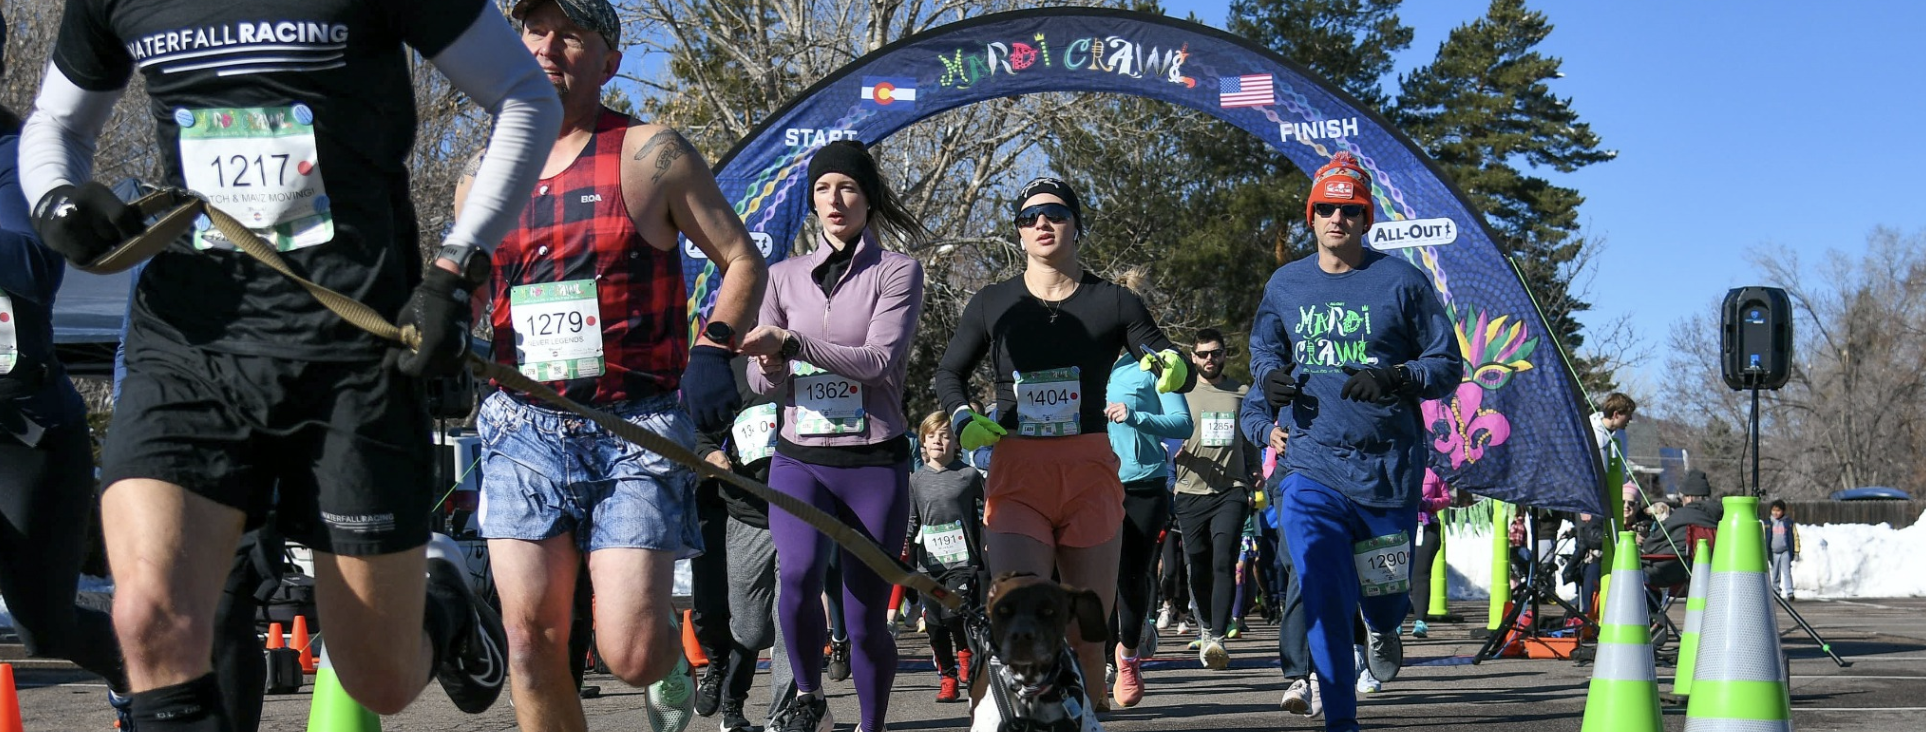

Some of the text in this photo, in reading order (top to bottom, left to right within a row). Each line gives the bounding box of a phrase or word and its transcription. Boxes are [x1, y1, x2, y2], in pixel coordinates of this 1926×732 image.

[937, 32, 1197, 90] MARDI CRAWL
[785, 128, 858, 147] START
[1279, 117, 1359, 143] FINISH
[211, 154, 290, 188] 1217
[232, 194, 239, 203] &
[268, 188, 315, 202] MOVING!
[580, 193, 603, 204] BOA
[526, 311, 583, 337] 1279
[1295, 304, 1372, 339] MARDI
[551, 336, 584, 345] LEGENDS
[1295, 334, 1379, 367] CRAWL
[806, 381, 850, 401] 1362
[1027, 388, 1069, 406] 1404
[741, 420, 768, 439] 130
[1209, 422, 1229, 431] 1285
[932, 534, 957, 547] 1191
[1367, 550, 1406, 570] 1290
